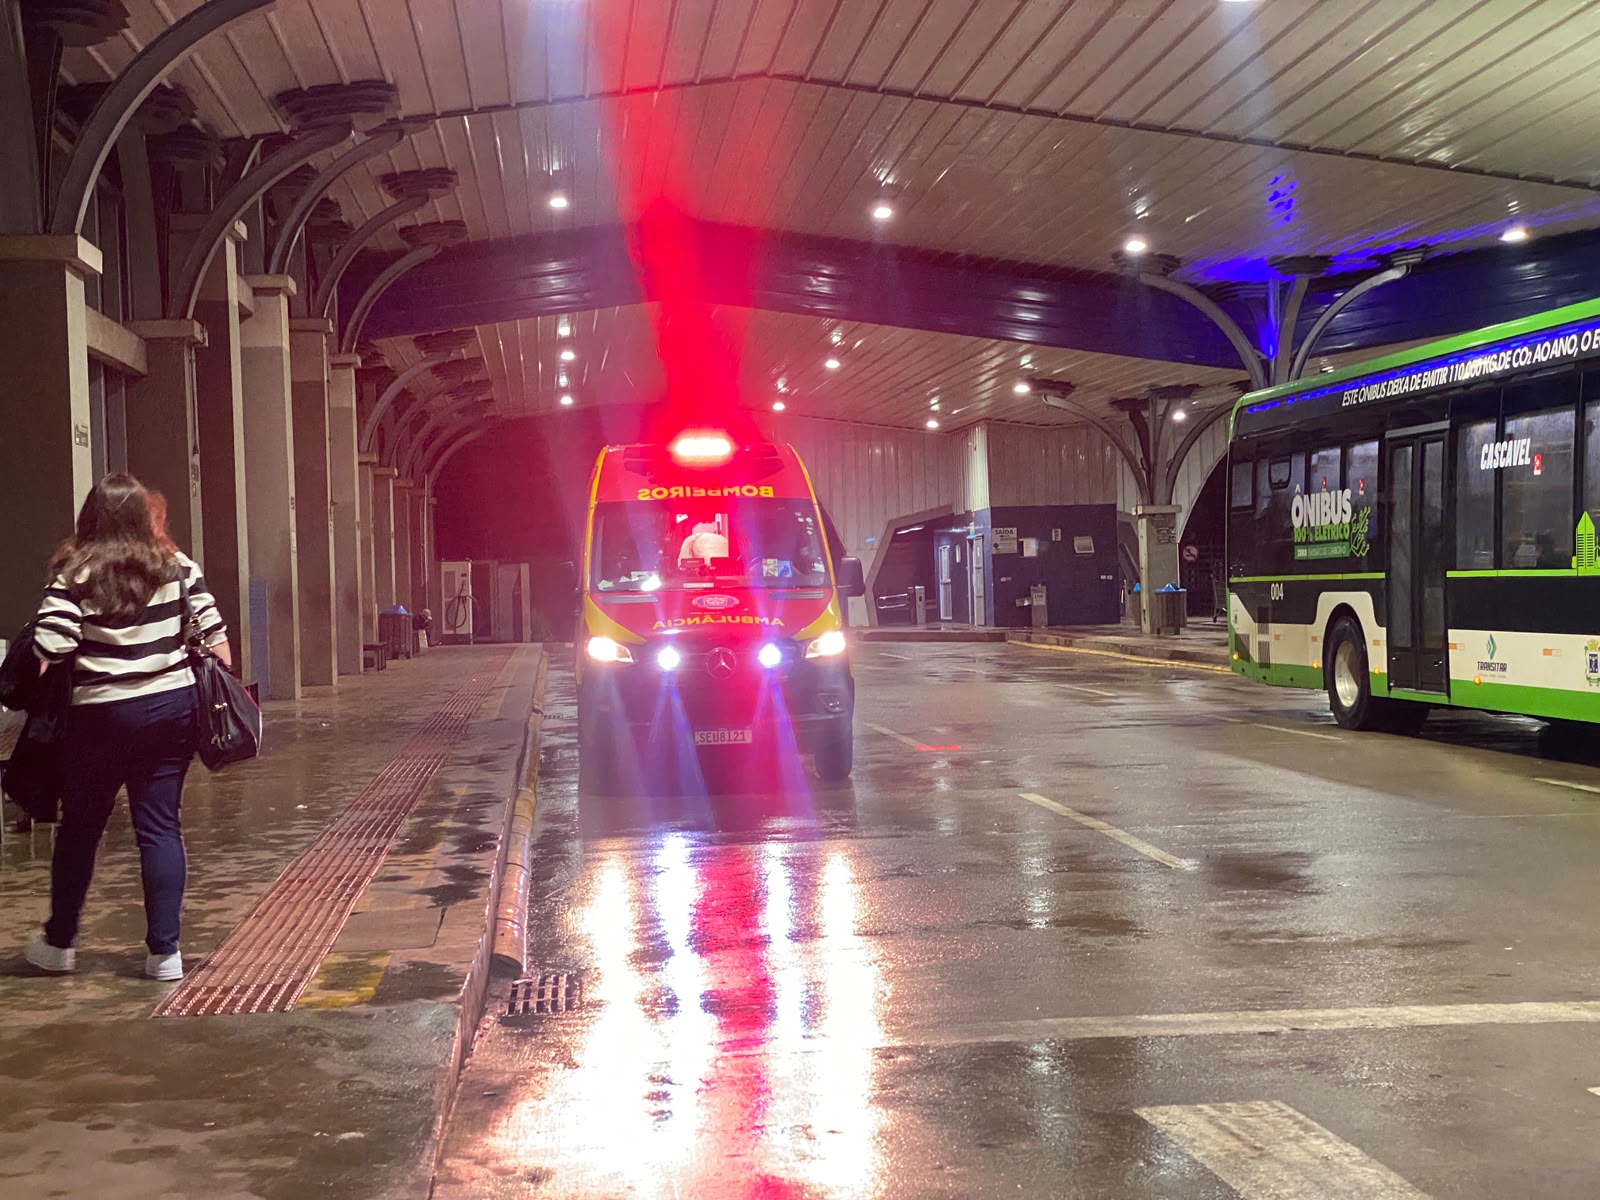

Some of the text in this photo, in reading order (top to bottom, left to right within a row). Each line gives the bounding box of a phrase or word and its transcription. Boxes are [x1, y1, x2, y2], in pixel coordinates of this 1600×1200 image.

[1342, 388, 1359, 407] ESTE
[1386, 374, 1409, 397] DEIXA
[1409, 371, 1422, 391] DE
[1421, 366, 1448, 389] EMITIR
[1498, 349, 1513, 371] DE
[1580, 330, 1592, 352] O
[1480, 437, 1531, 471] CASCAVEL
[1291, 483, 1352, 529] ÔNIBUS
[1270, 583, 1284, 600] 004
[1477, 661, 1508, 673] TRANSITAR
